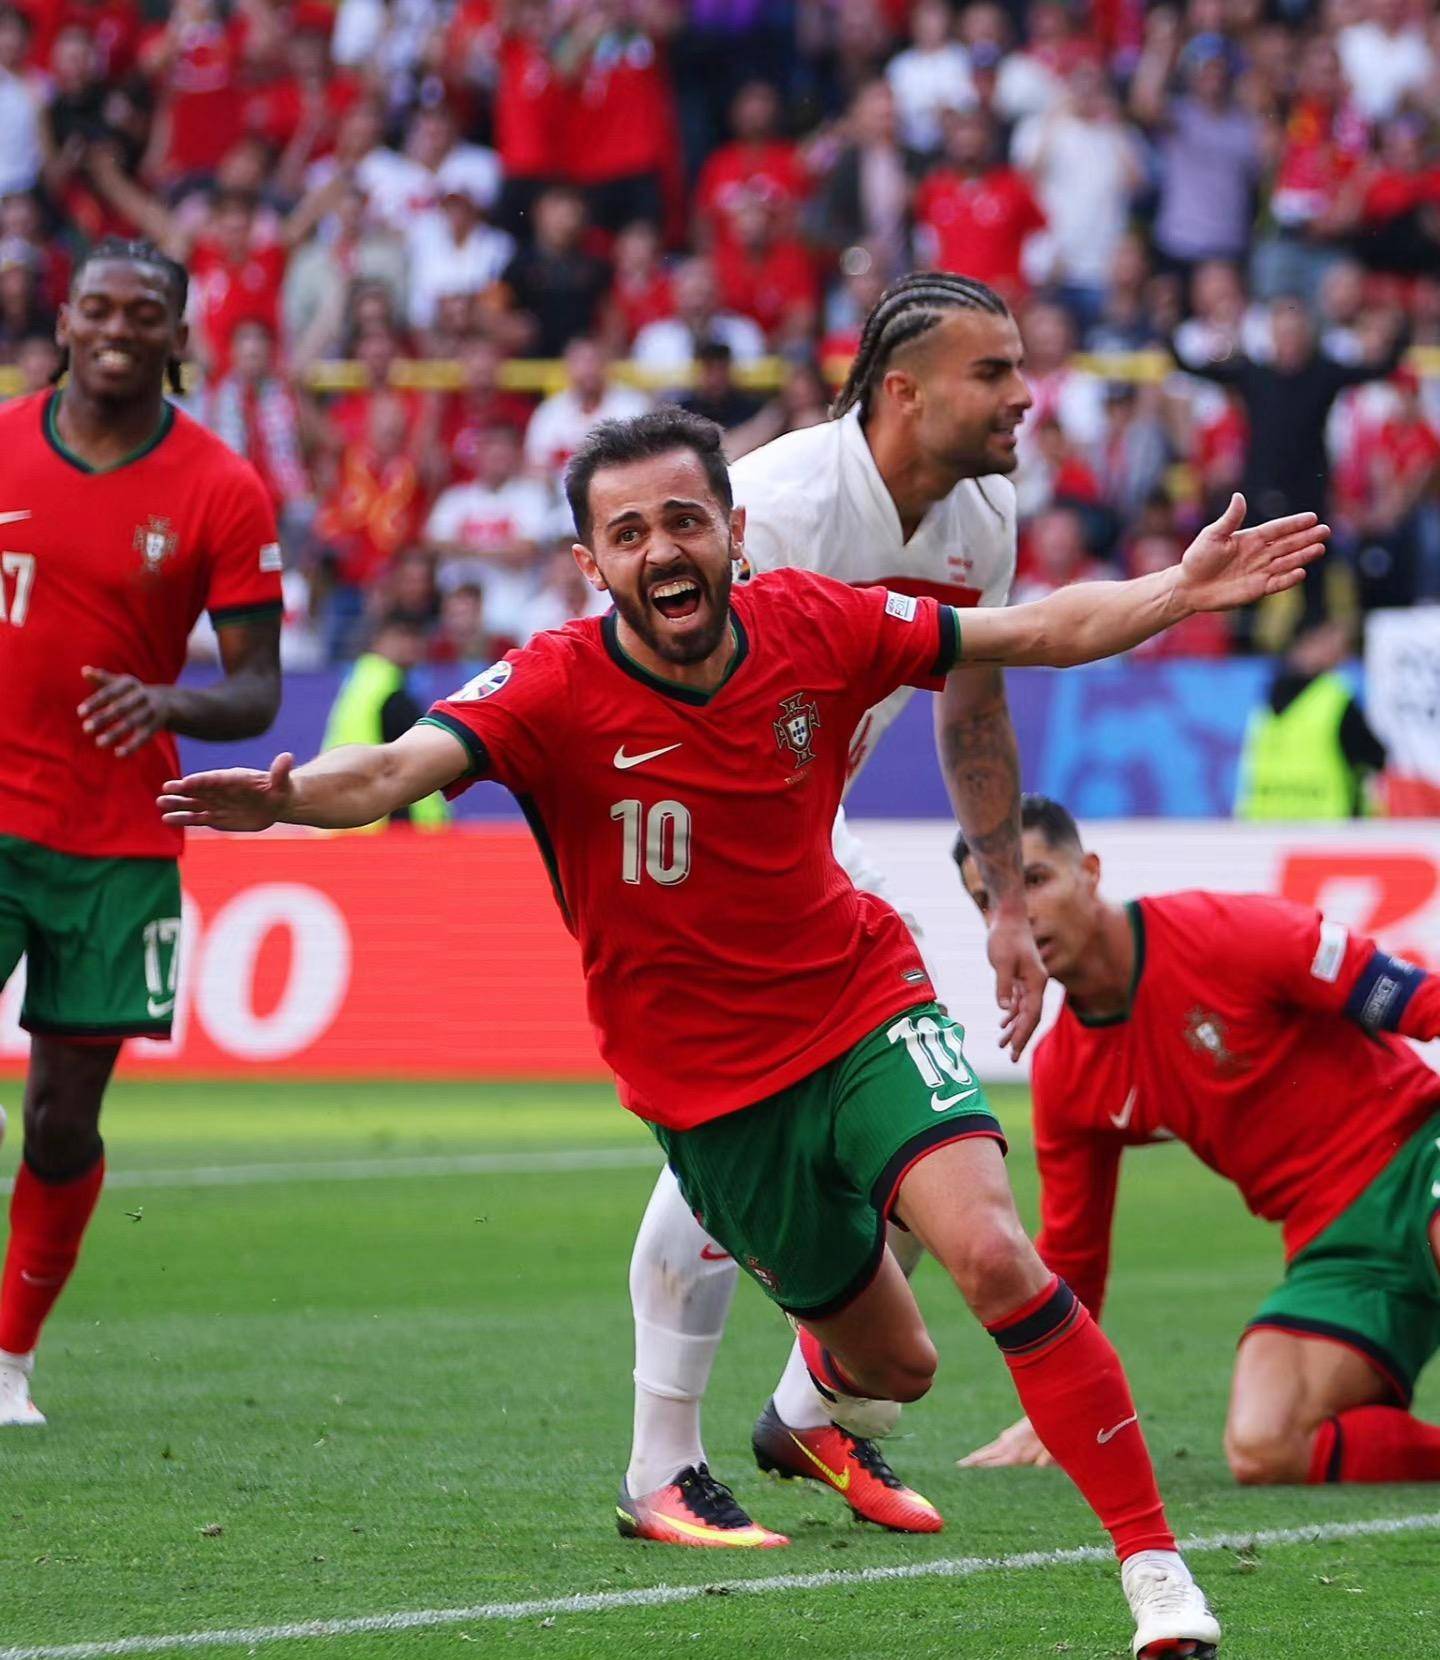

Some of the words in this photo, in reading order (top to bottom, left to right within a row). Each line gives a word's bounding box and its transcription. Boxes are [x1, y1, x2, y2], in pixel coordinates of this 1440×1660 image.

[610, 799, 692, 886] 10
[143, 916, 181, 996] 17
[886, 1016, 974, 1088] 10
